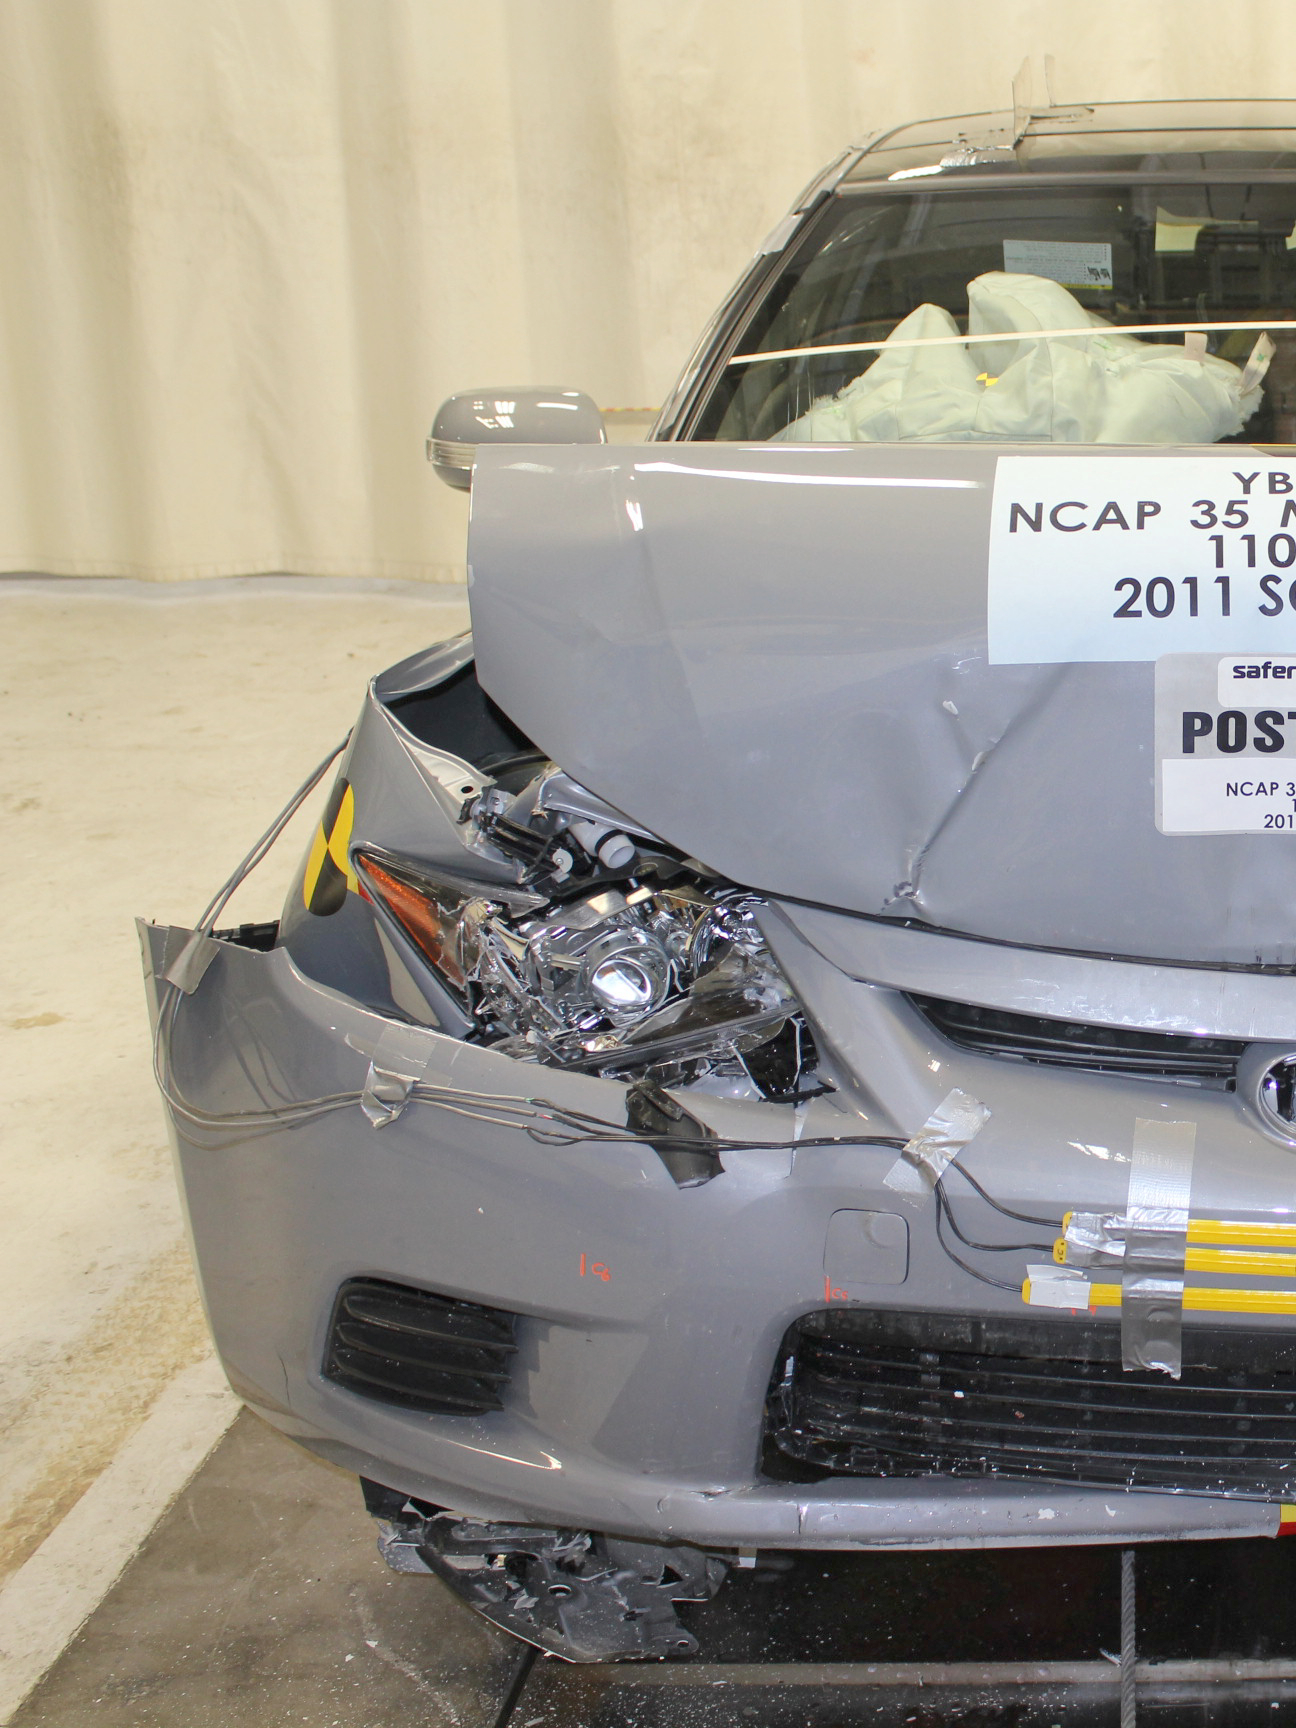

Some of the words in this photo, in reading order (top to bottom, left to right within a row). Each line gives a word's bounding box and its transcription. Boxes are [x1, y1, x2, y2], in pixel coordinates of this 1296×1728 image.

[1010, 502, 1161, 532] NCAP
[1191, 500, 1248, 529] 35
[1114, 577, 1229, 618] 2011
[1227, 782, 1278, 796] NCAP
